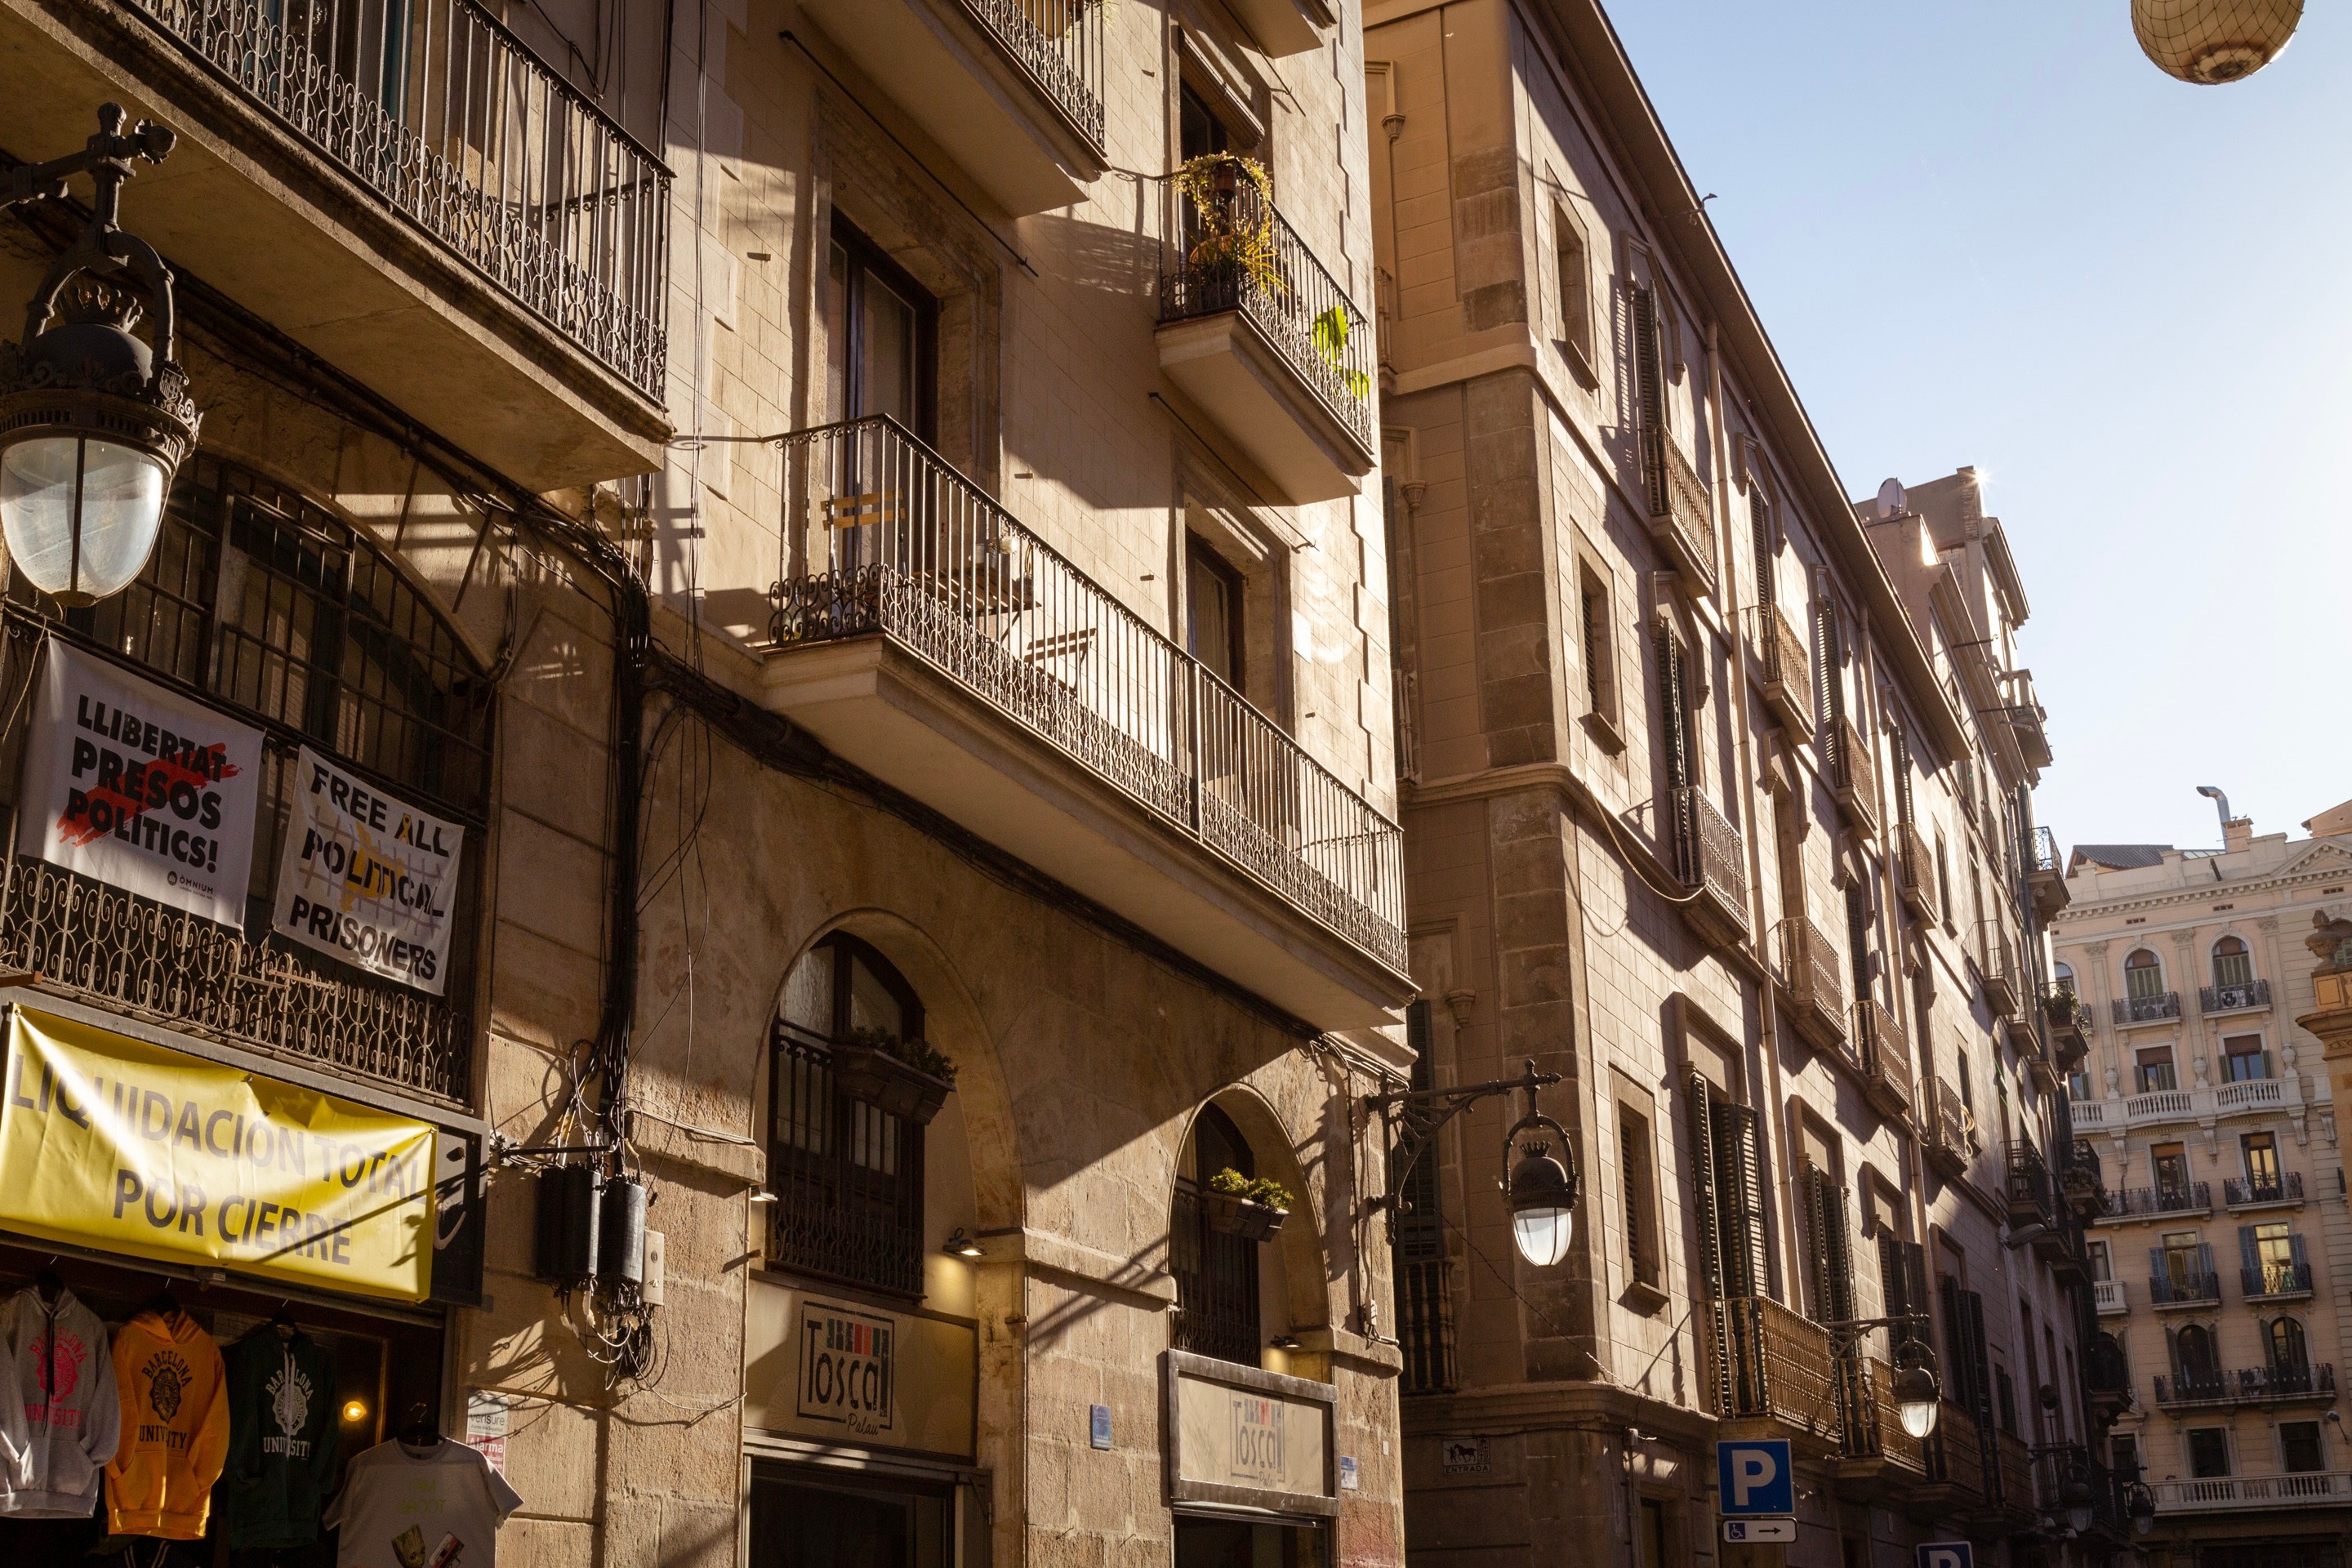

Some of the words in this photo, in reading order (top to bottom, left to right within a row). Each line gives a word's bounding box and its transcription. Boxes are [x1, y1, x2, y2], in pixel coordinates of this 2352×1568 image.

[77, 694, 227, 783] LLIBERTAT
[72, 736, 222, 830] PRESOS
[310, 763, 388, 833] FREE
[394, 813, 449, 858] ALL
[66, 786, 219, 874] POLÍTICS!
[179, 874, 214, 895] ÒMNIUM
[301, 827, 444, 918] POLITICAL
[289, 894, 437, 981] PRISONERS
[10, 1054, 306, 1177] LIQUIDACIÓN
[114, 1169, 207, 1236] POR
[314, 1134, 427, 1206] TOTAL
[217, 1193, 352, 1266] CIERRE
[141, 1350, 193, 1388] BARCELONA
[265, 1369, 314, 1401] BARLONA
[469, 1437, 504, 1454] Alarma
[847, 1412, 880, 1436] Palau
[1446, 1465, 1489, 1474] ENTRADA
[1731, 1449, 1776, 1506] P
